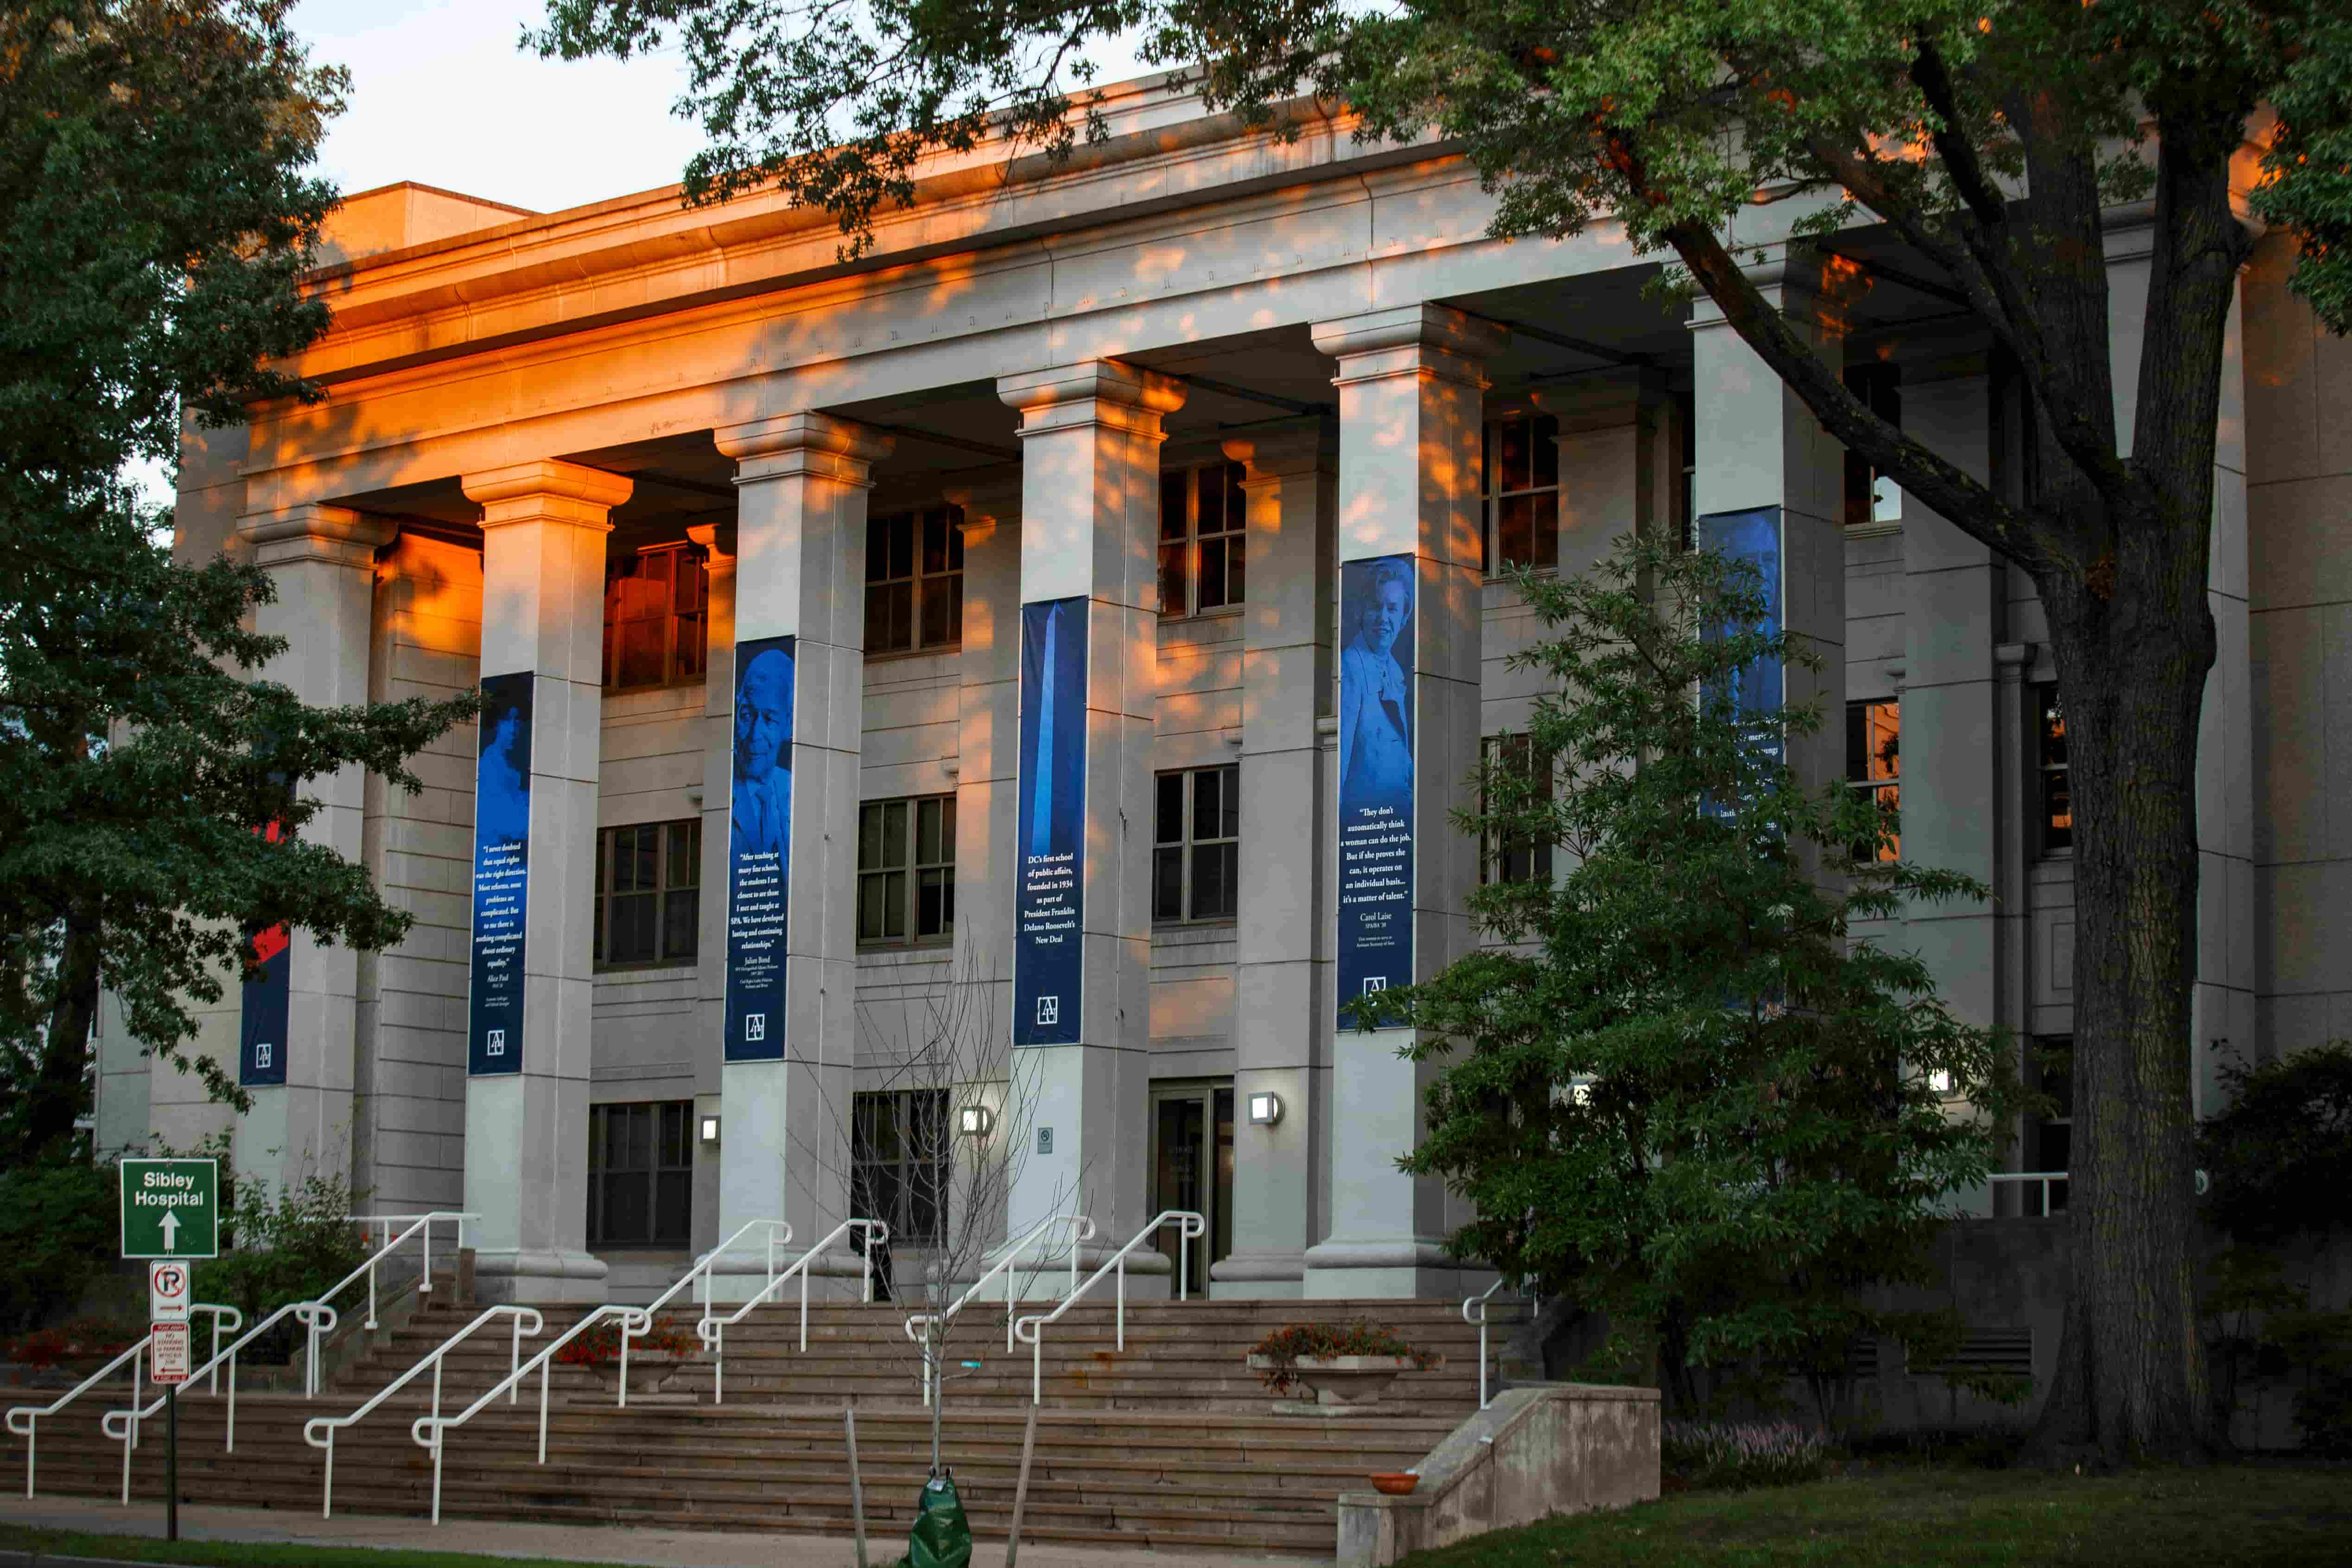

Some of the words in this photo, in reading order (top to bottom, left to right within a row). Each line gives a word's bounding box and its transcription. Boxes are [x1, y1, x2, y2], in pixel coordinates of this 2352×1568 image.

[1348, 821, 1387, 832] automatically
[1389, 819, 1405, 828] think
[1380, 835, 1387, 844] do
[1389, 834, 1399, 843] the
[1399, 833, 1411, 844] job.
[755, 852, 773, 860] teaching
[1055, 853, 1073, 861] school
[1359, 851, 1364, 860] if
[1365, 851, 1375, 859] she
[1376, 851, 1395, 860] proves
[1396, 848, 1405, 857] she
[1036, 868, 1053, 879] public
[1054, 866, 1073, 875] affairs,
[1369, 866, 1393, 875] operates
[1027, 881, 1050, 891] founded
[1059, 880, 1073, 889] 1934
[1354, 878, 1385, 889] individual
[1043, 896, 1055, 905] part
[1378, 892, 1386, 901] of
[759, 901, 774, 912] taught
[762, 913, 784, 923] developed
[1024, 909, 1050, 919] President
[1051, 907, 1075, 916] Franklin
[1360, 912, 1376, 922] Carol
[748, 927, 757, 937] and
[758, 927, 782, 936] continuing
[1024, 923, 1044, 932] Delano
[1036, 936, 1049, 945] New
[1049, 934, 1062, 943] Deal
[1040, 997, 1057, 1024] AU
[748, 1014, 765, 1040] AU
[144, 1172, 194, 1189] Sibley
[135, 1191, 203, 1208] Hospital
